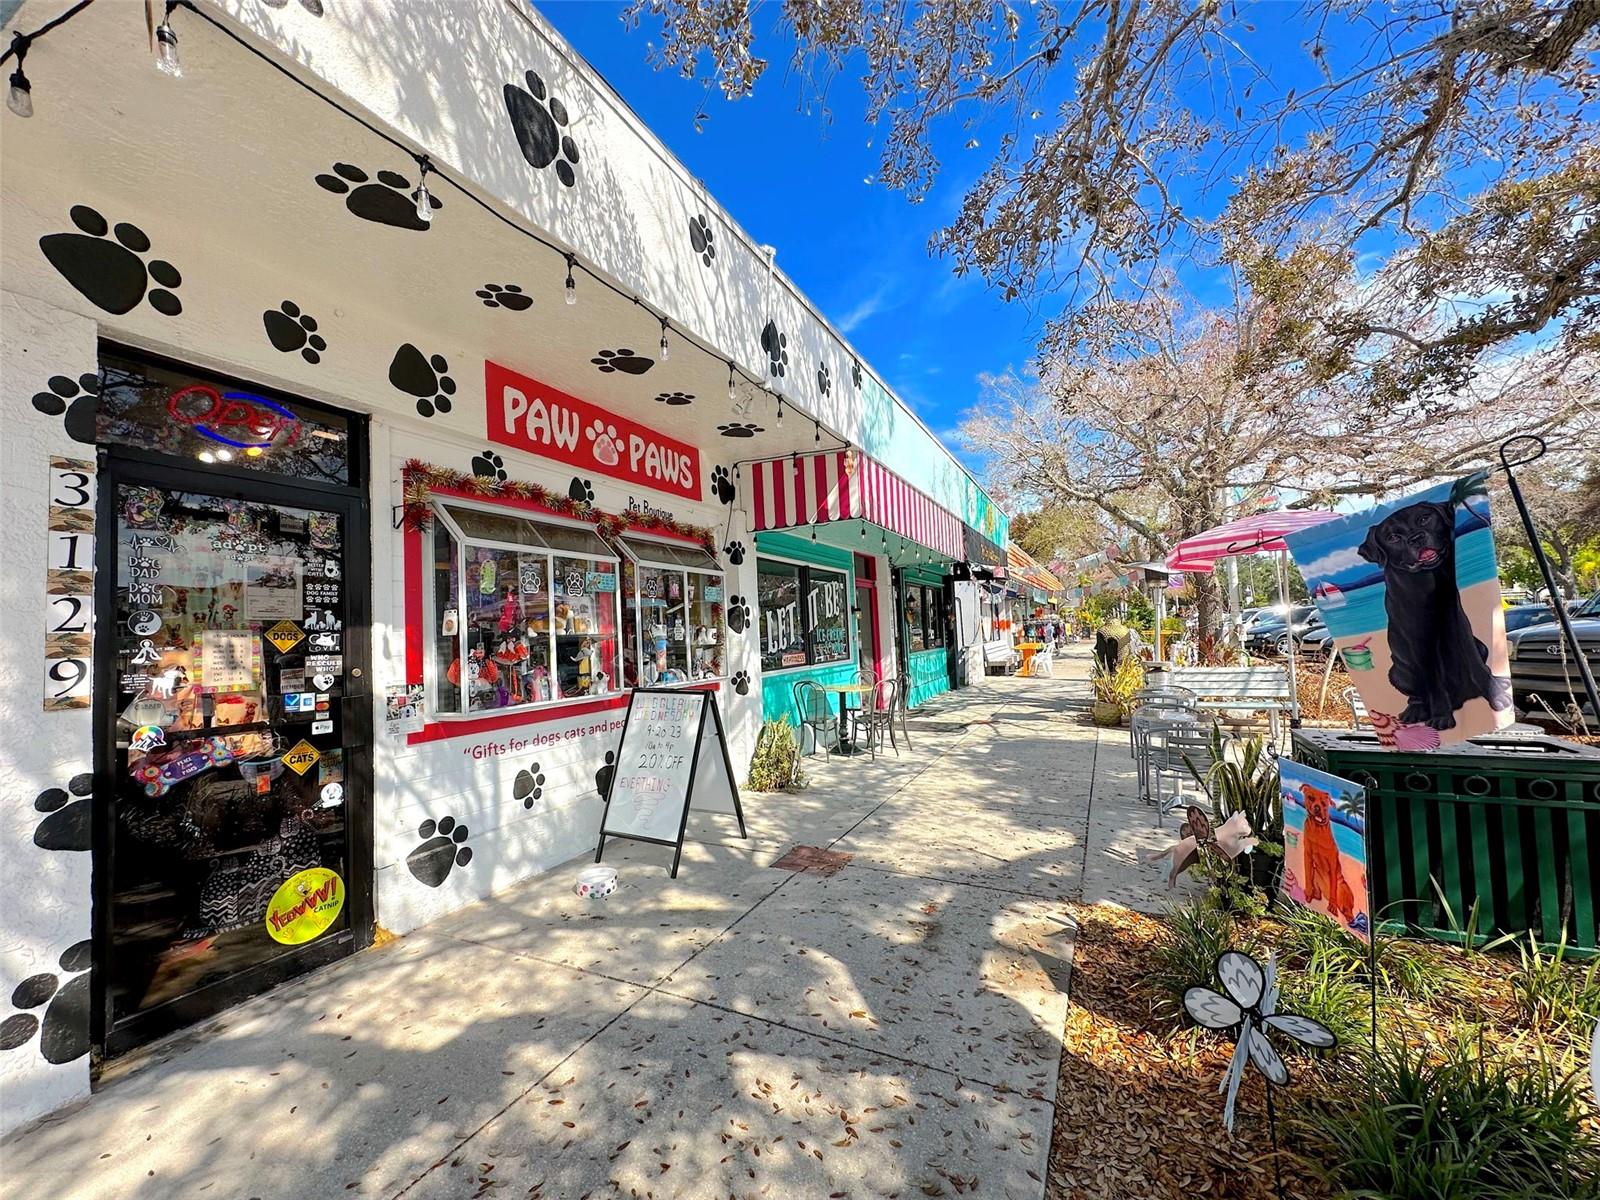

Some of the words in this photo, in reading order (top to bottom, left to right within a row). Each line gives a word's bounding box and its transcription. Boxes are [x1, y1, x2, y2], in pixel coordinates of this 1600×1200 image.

[503, 385, 579, 453] PAW
[629, 433, 693, 489] PAWS
[131, 567, 159, 578] DAD
[128, 593, 163, 606] MOM
[765, 601, 796, 655] LET
[807, 587, 819, 633] IT
[824, 580, 840, 619] BE
[509, 738, 528, 751] for
[532, 732, 561, 748] dogs
[564, 725, 586, 740] cats
[588, 720, 607, 736] and
[289, 754, 314, 764] CATS
[313, 900, 339, 913] CATNIP
